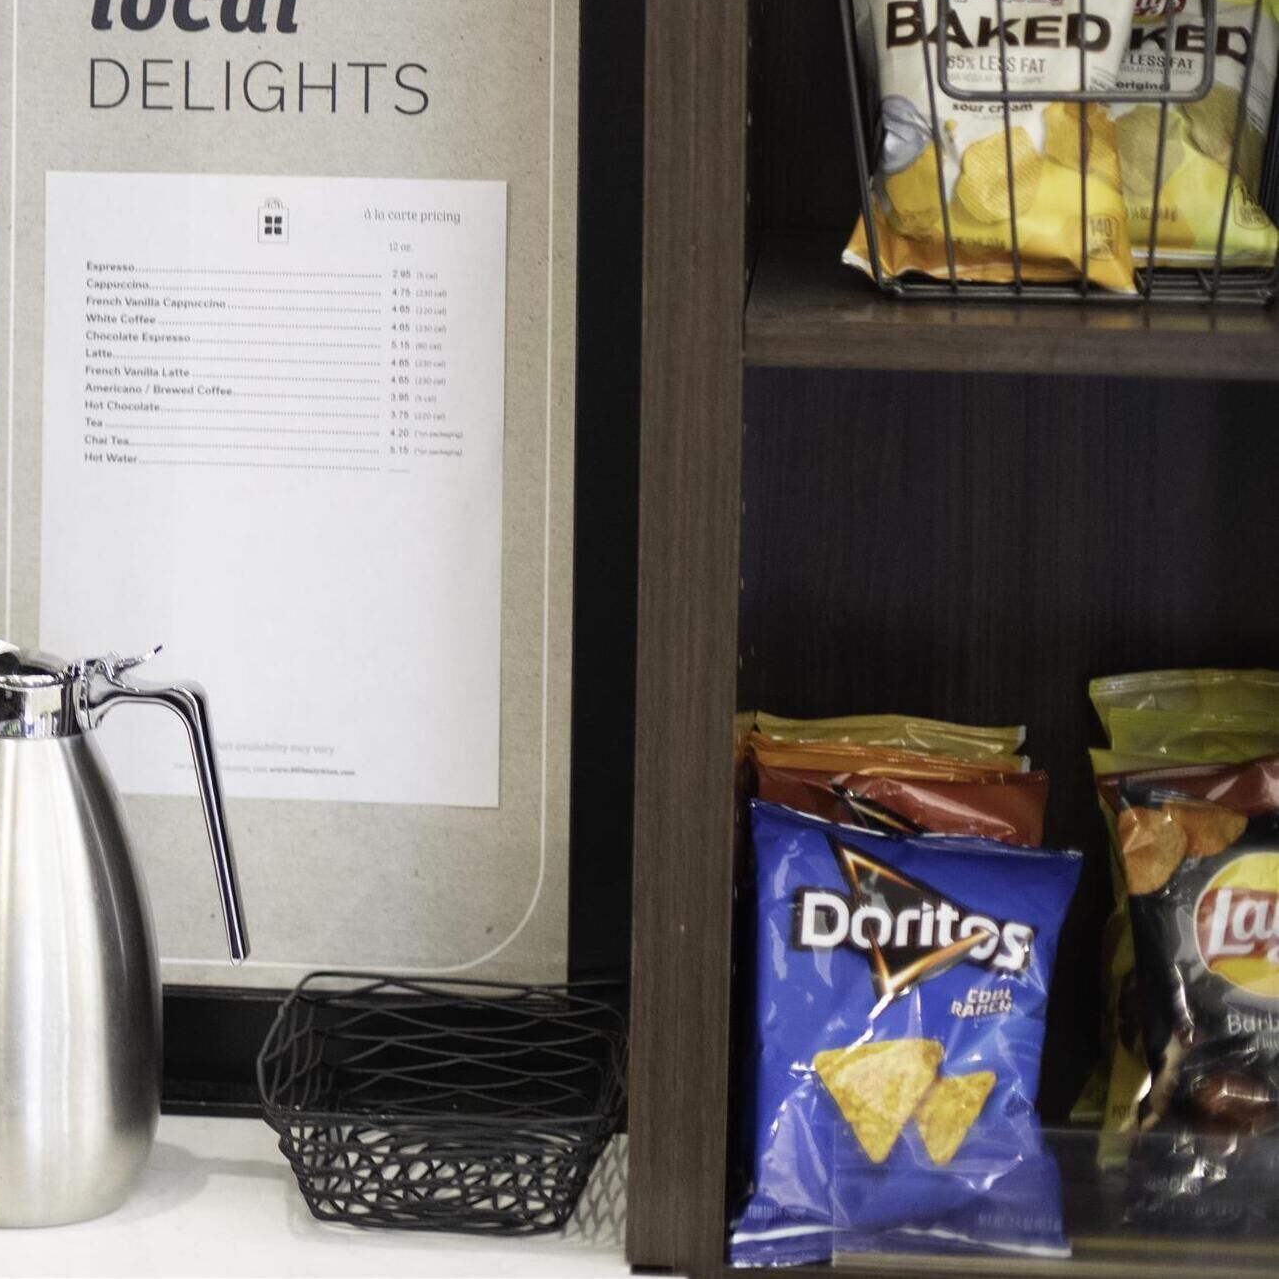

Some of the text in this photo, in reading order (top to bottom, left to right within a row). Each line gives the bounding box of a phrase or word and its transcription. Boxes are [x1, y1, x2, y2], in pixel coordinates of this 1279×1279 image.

[886, 0, 1112, 53] BAKED
[1129, 25, 1251, 66] KED
[1020, 57, 1047, 73] FAT
[89, 57, 431, 116] DELIGHTS
[952, 102, 1034, 114] sour cram
[420, 211, 461, 225] pricing
[86, 261, 135, 273] Espresso
[86, 278, 149, 291] Cappuccino
[86, 295, 122, 306] French
[124, 297, 160, 307] Vanilla
[162, 297, 227, 310] Cappuccino
[85, 313, 117, 323] White
[120, 313, 156, 324] Coffee
[85, 330, 139, 341] Chocolate
[142, 331, 191, 343] Espresso
[85, 348, 113, 359] Latte
[84, 365, 121, 376] French
[123, 366, 159, 377] Vanilla
[161, 367, 190, 377] Latte
[84, 383, 142, 394] Americano
[153, 384, 194, 395] Brewed
[197, 384, 233, 395] Coffee
[84, 400, 103, 411] Hot
[106, 401, 160, 412] Chocolate
[84, 417, 103, 428] Tea
[84, 435, 108, 445] Chai
[111, 435, 129, 445] Tea
[84, 452, 138, 464] Hot Water
[798, 888, 1036, 972] Doritos
